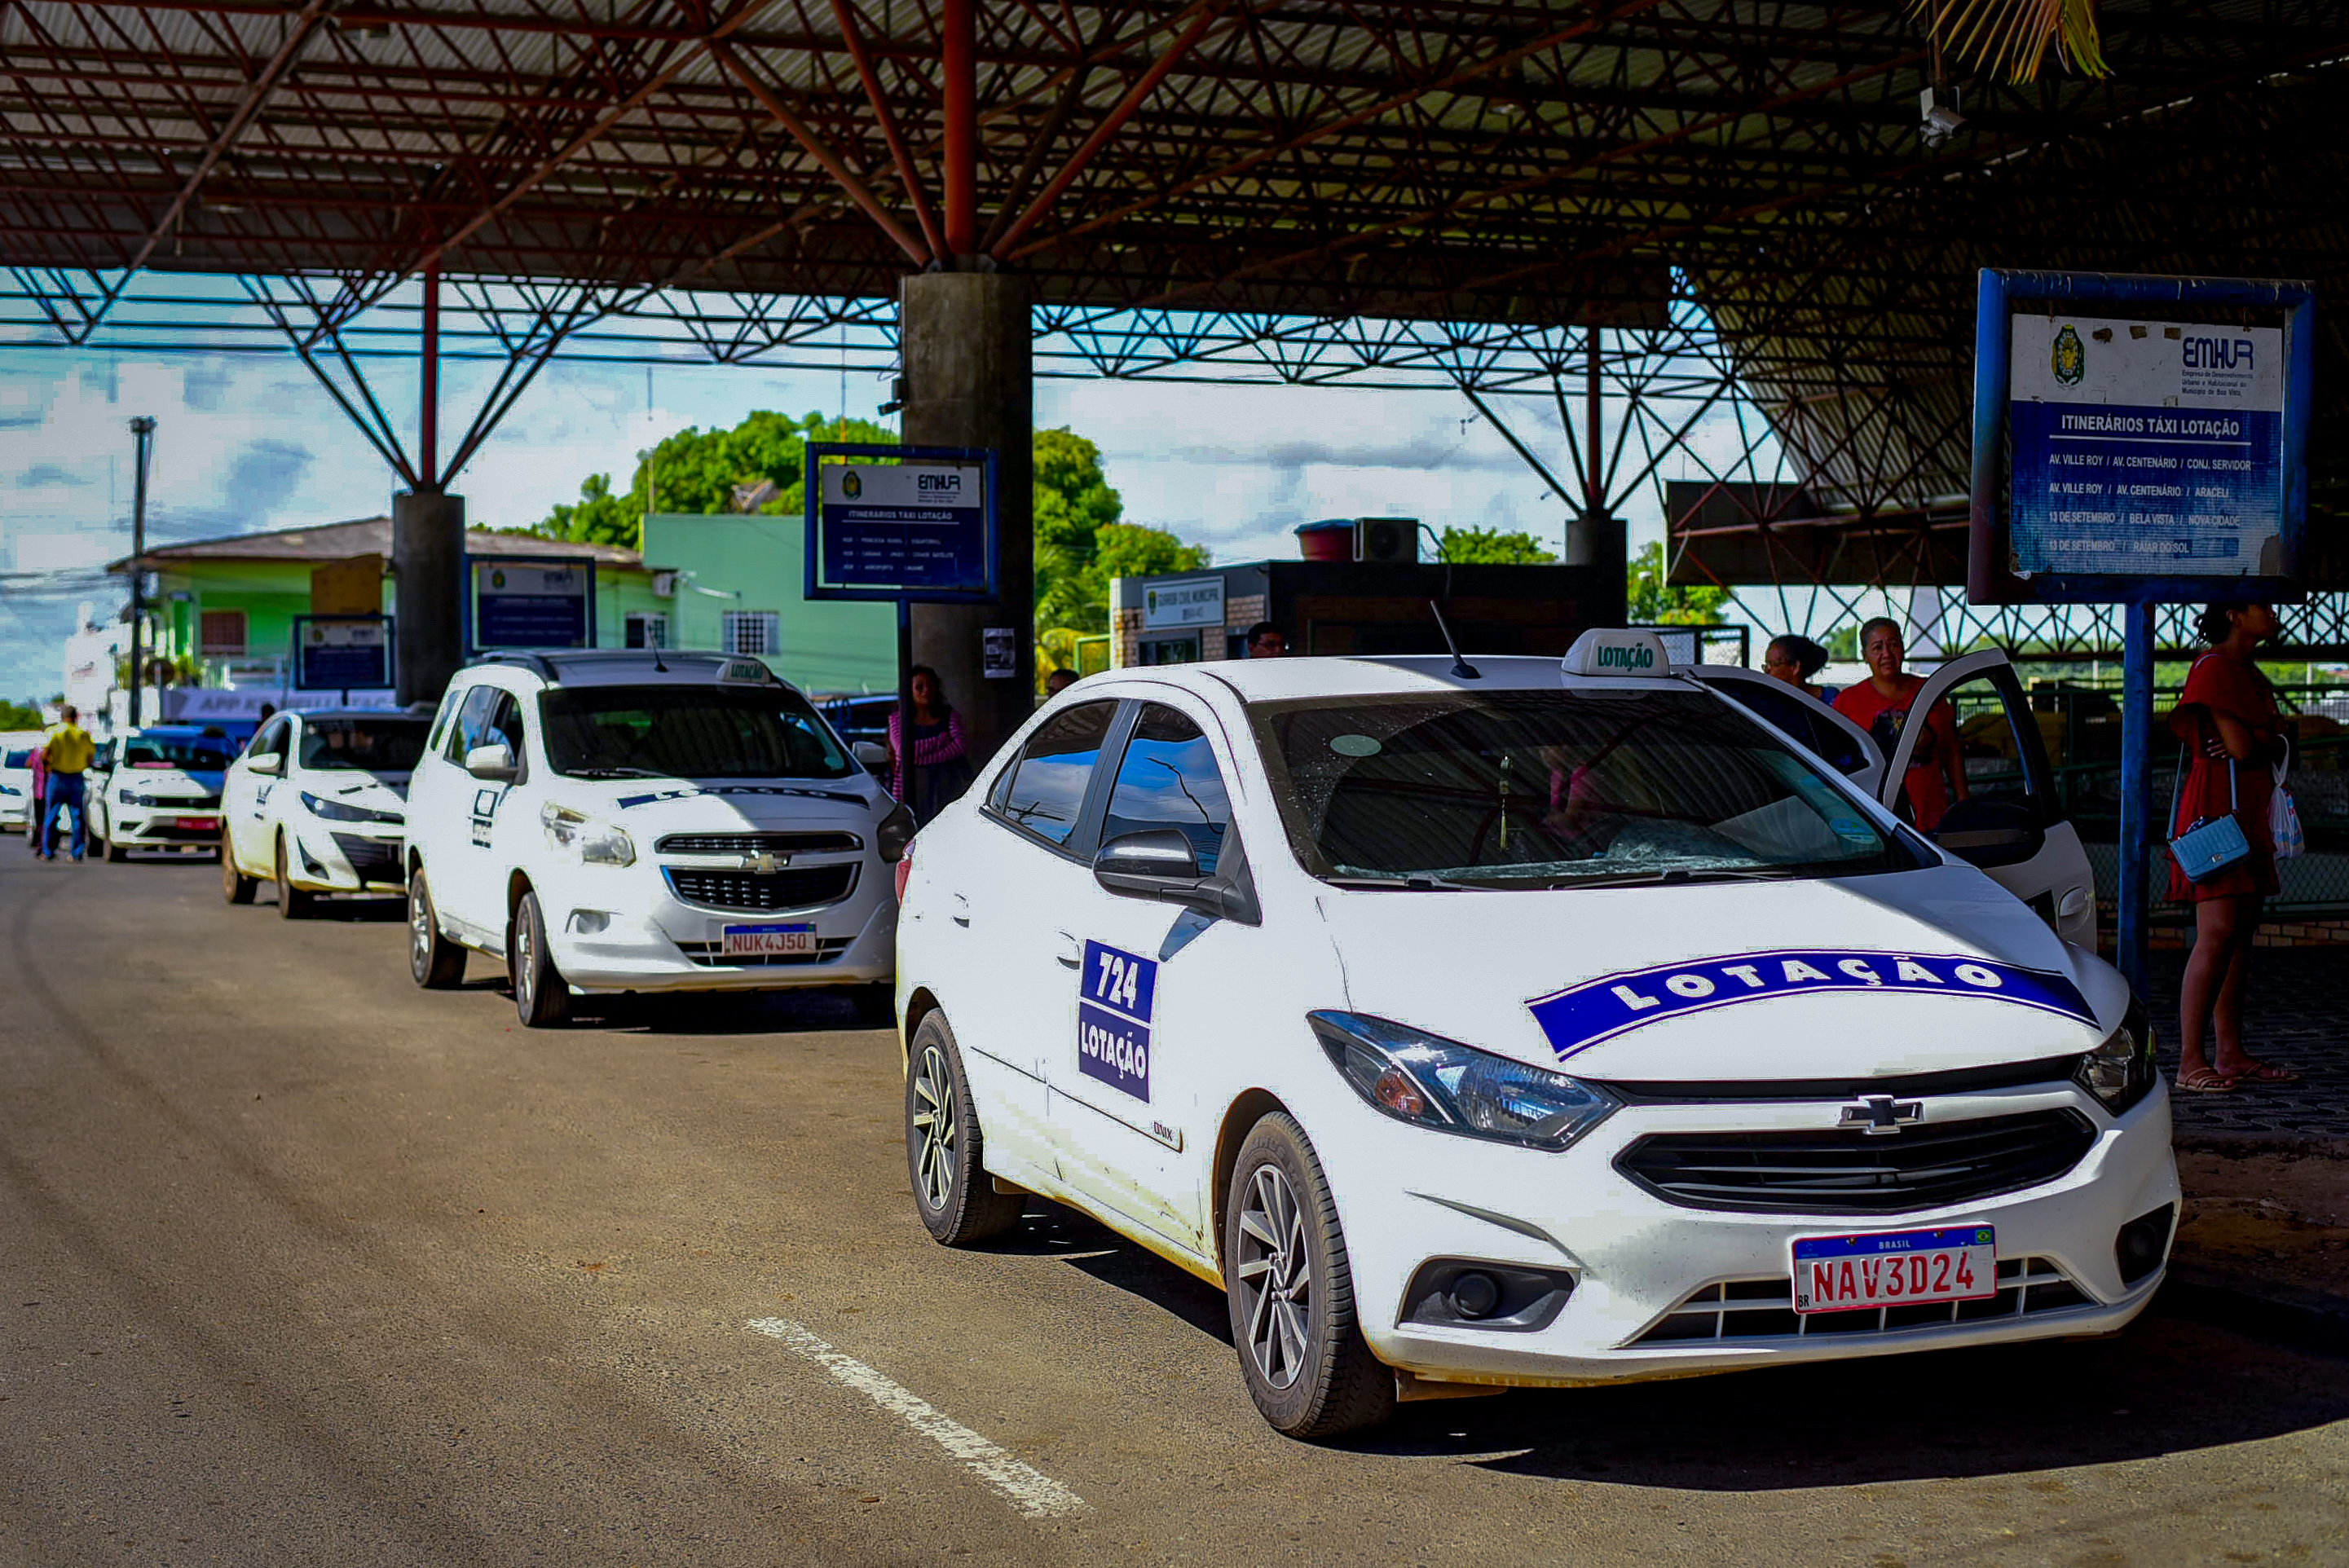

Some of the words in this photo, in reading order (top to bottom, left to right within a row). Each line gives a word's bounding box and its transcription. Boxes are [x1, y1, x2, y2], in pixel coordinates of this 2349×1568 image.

[2183, 337, 2254, 370] EMHUR
[2061, 413, 2144, 433] ITINERÁRIOS
[2147, 416, 2177, 434] TÁXI
[2180, 418, 2240, 439] LOTAÇÃO
[2049, 454, 2061, 465] AV.
[2063, 454, 2084, 465] VILLE
[2087, 455, 2103, 466] ROY
[2113, 456, 2125, 466] AV.
[2126, 455, 2177, 469] CENTENÁRIO
[2187, 459, 2210, 470] CONJ.
[2212, 460, 2251, 471] SERVIDOR
[2049, 483, 2061, 493] AV.
[2062, 483, 2084, 494] VILLE
[2087, 484, 2103, 495] ROY
[2117, 485, 2128, 496] AV.
[2130, 483, 2181, 497] CENTENÁRIO
[2194, 487, 2228, 498] ARACELI
[2059, 511, 2070, 522] DE
[2071, 512, 2116, 523] SETEMBRO
[2130, 513, 2151, 525] BELA
[2152, 513, 2175, 526] VISTA
[2188, 515, 2210, 526] NOVA
[2210, 515, 2240, 526] CIDADE
[2059, 540, 2070, 551] DE
[2071, 540, 2115, 552] SETEMBRO
[2174, 542, 2189, 553] SOL
[1598, 642, 1654, 672] LOTAÇÃO
[733, 934, 806, 952] NUK4J50
[1096, 952, 1139, 1010] 724
[1611, 956, 2003, 1011] LOTAÇÃO
[1081, 1021, 1147, 1080] LOTAÇÃO
[1879, 1240, 1910, 1249] BRASIL
[1812, 1251, 1974, 1302] NAV3D24
[1798, 1294, 1809, 1307] BR
